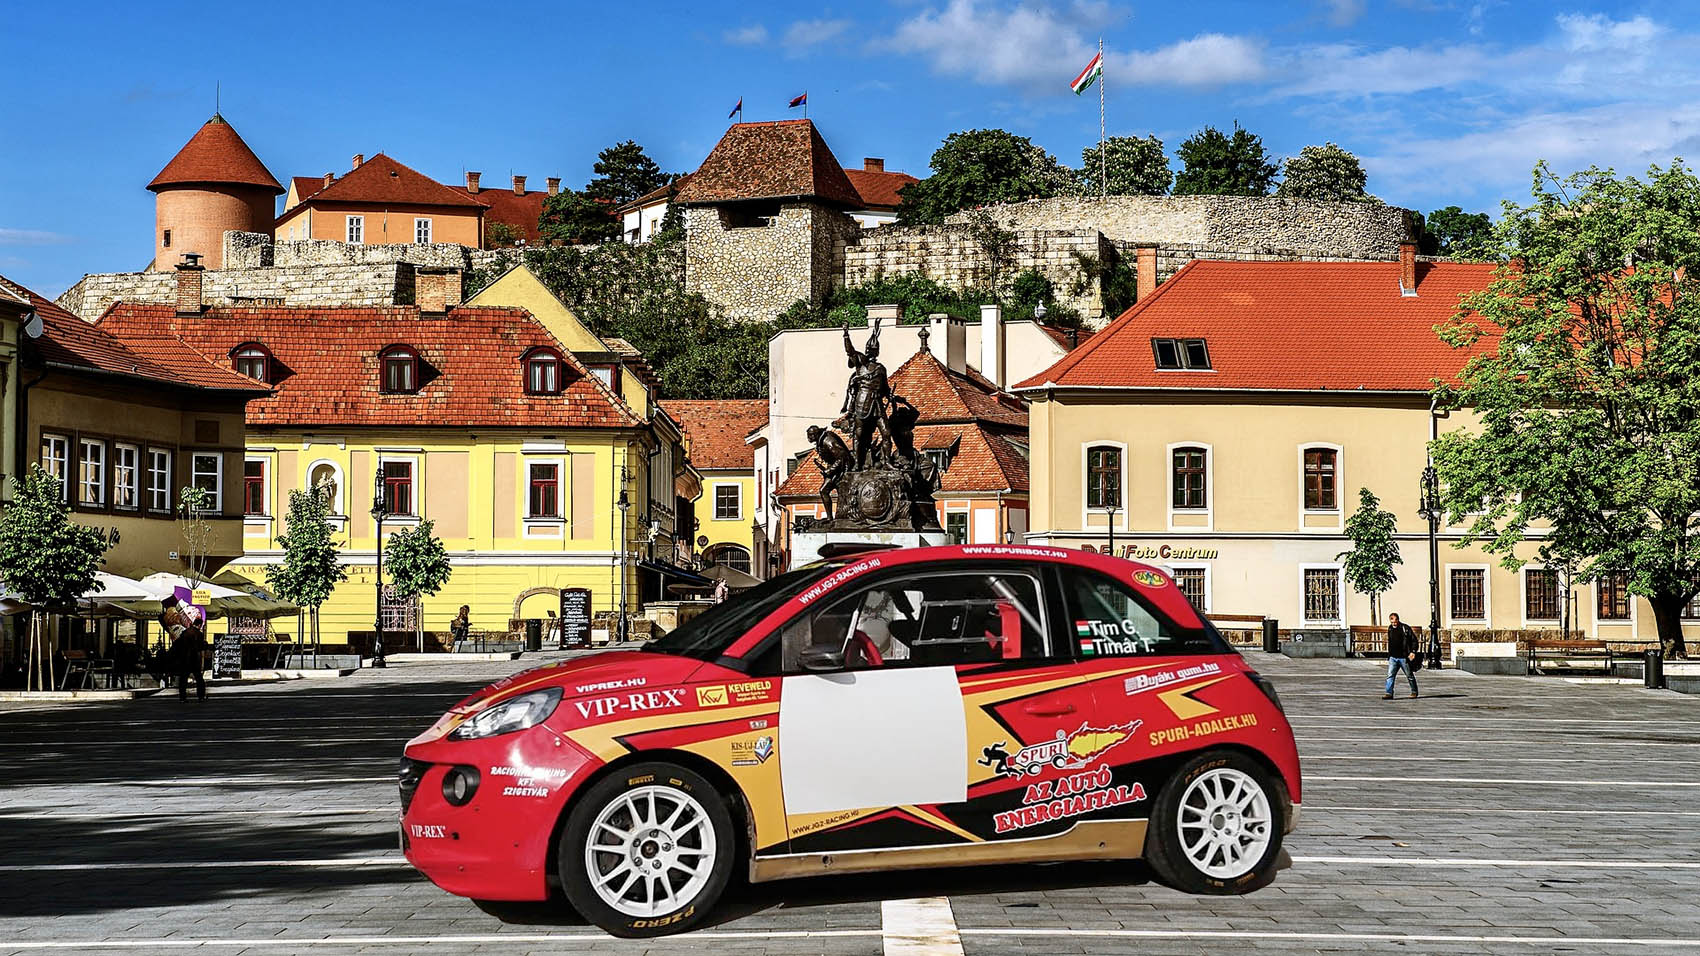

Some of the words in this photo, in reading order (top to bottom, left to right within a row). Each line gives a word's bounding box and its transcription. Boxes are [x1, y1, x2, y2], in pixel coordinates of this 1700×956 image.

[799, 558, 881, 604] WWW.JG2-RACING.HU
[1121, 619, 1140, 635] G.
[1139, 636, 1156, 653] T.
[575, 677, 647, 694] VIPREX.HU
[1149, 713, 1258, 746] SPURI-ADALEK.HU
[1020, 743, 1064, 764] SPURI
[1023, 782, 1052, 804] AZ
[1055, 763, 1112, 798] AUTÓ
[993, 782, 1148, 833] ENERGIAITALA
